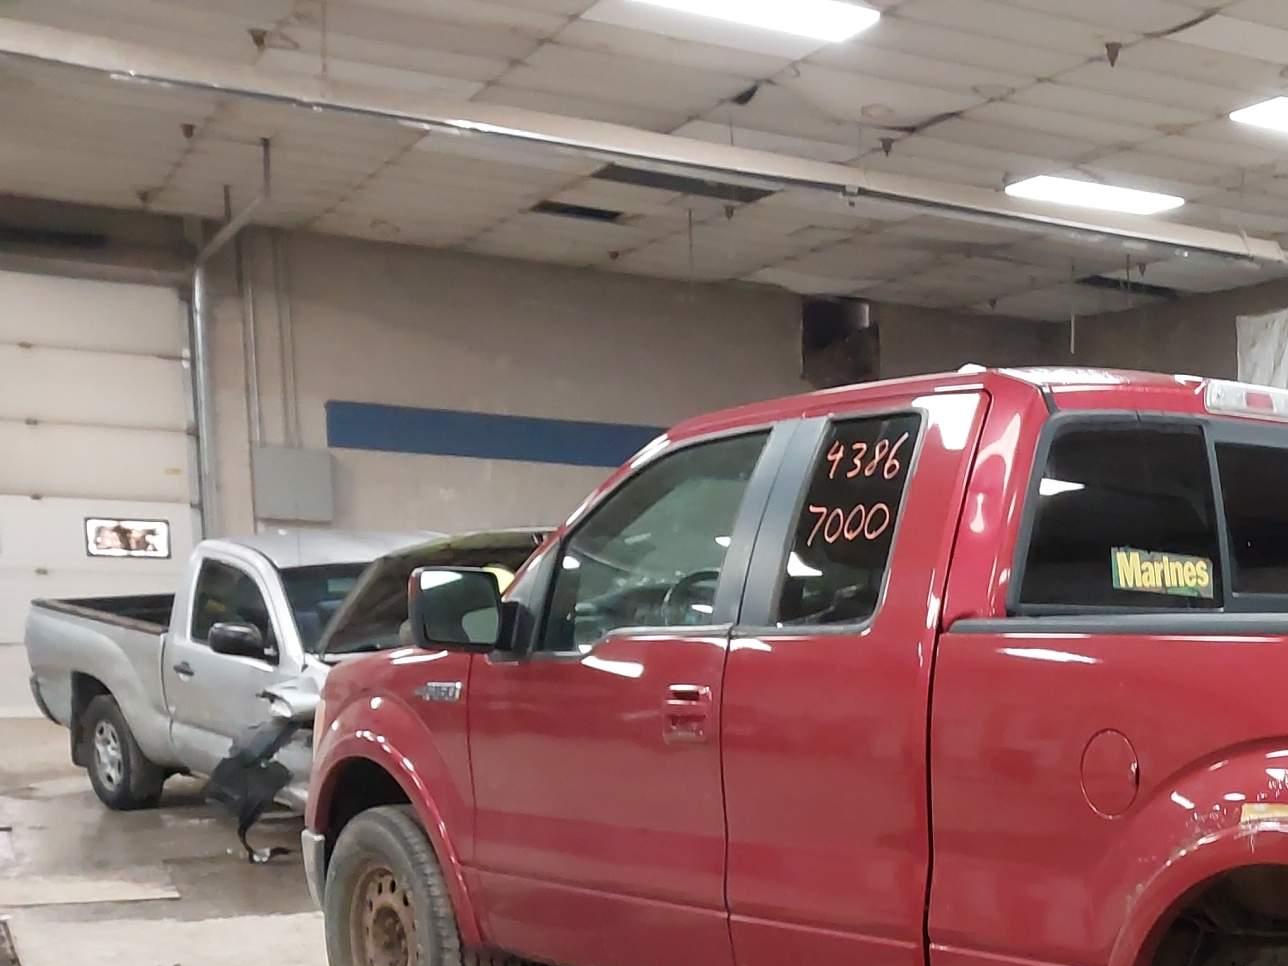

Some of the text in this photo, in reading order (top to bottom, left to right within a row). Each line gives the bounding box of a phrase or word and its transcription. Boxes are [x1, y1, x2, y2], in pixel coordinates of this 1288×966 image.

[827, 432, 909, 479] 4386
[807, 503, 890, 547] 7000
[1116, 551, 1209, 588] Marines
